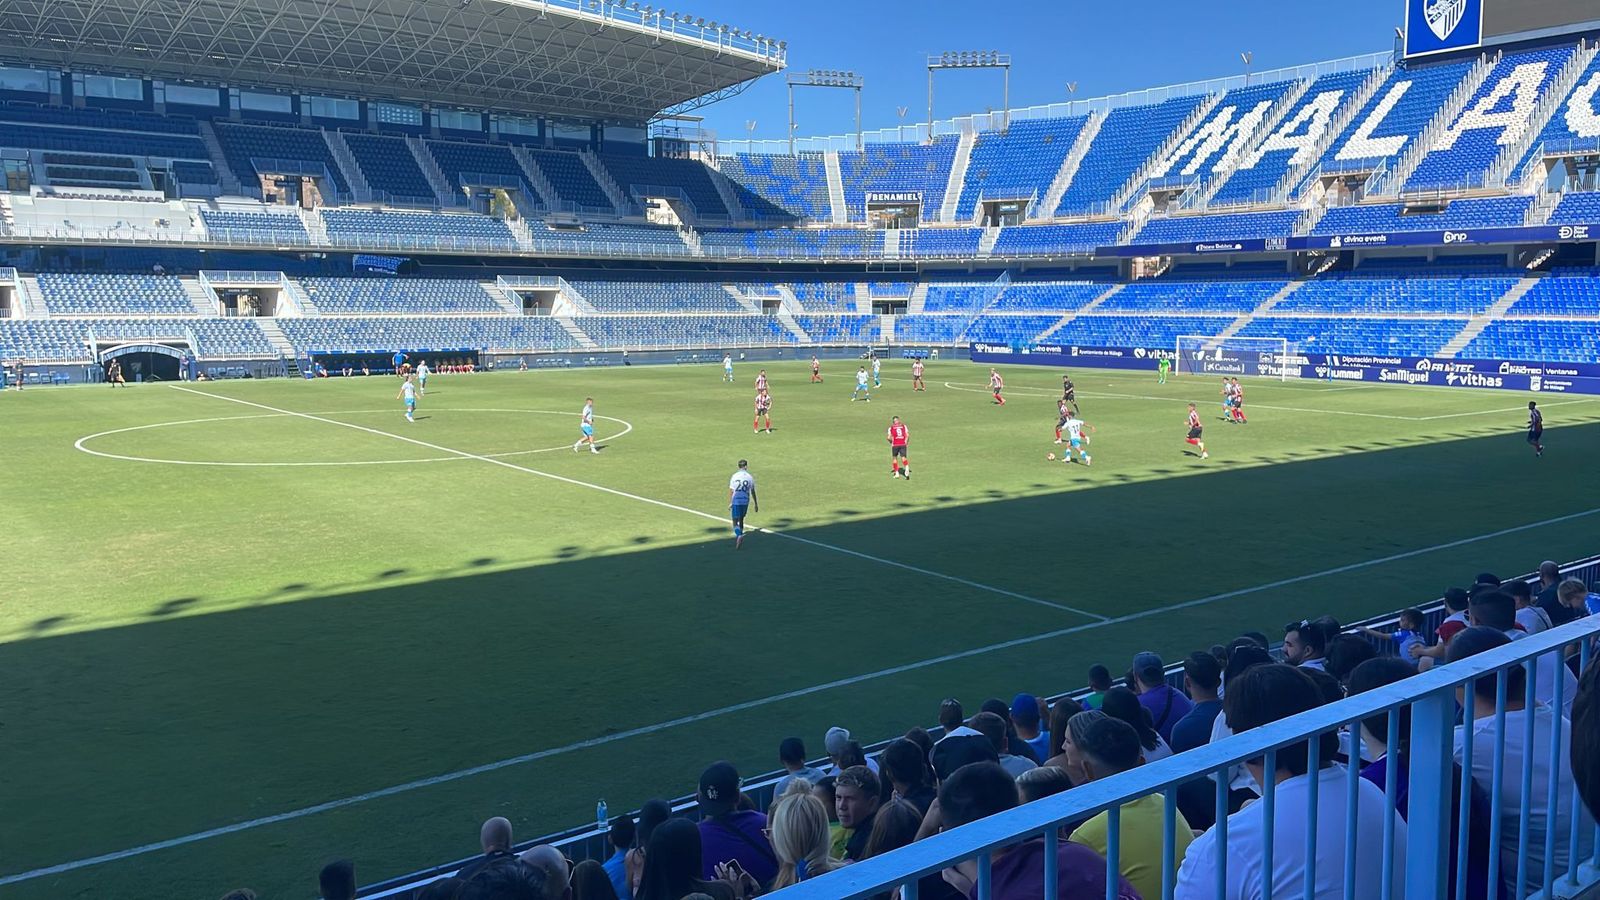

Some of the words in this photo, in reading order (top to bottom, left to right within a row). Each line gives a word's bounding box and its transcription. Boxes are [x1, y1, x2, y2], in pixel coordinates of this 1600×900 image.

[872, 193, 918, 201] BENAMIEL
[1459, 373, 1503, 387] vithas
[734, 479, 749, 492] 28
